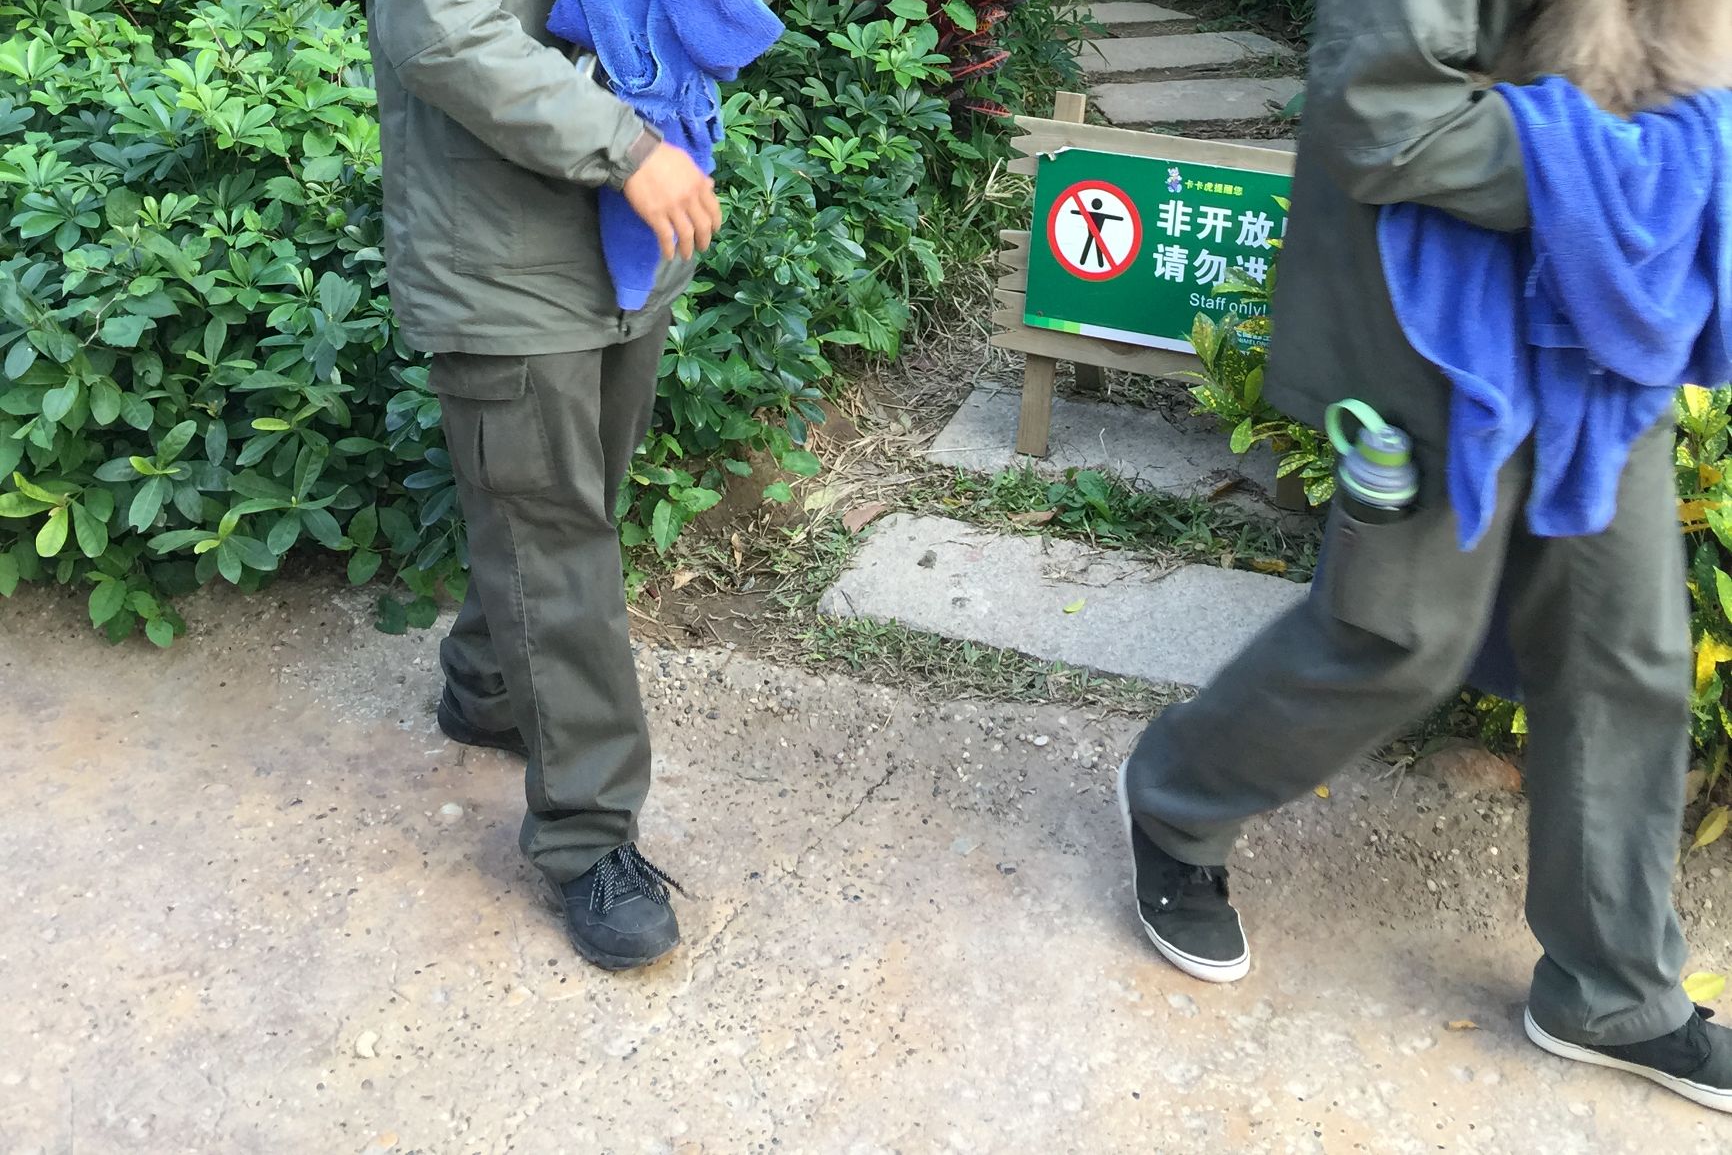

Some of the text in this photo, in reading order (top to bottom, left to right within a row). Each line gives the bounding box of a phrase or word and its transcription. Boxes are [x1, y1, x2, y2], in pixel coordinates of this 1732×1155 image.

[1156, 199, 1288, 250] 非开放
[1189, 292, 1227, 311] Staff
